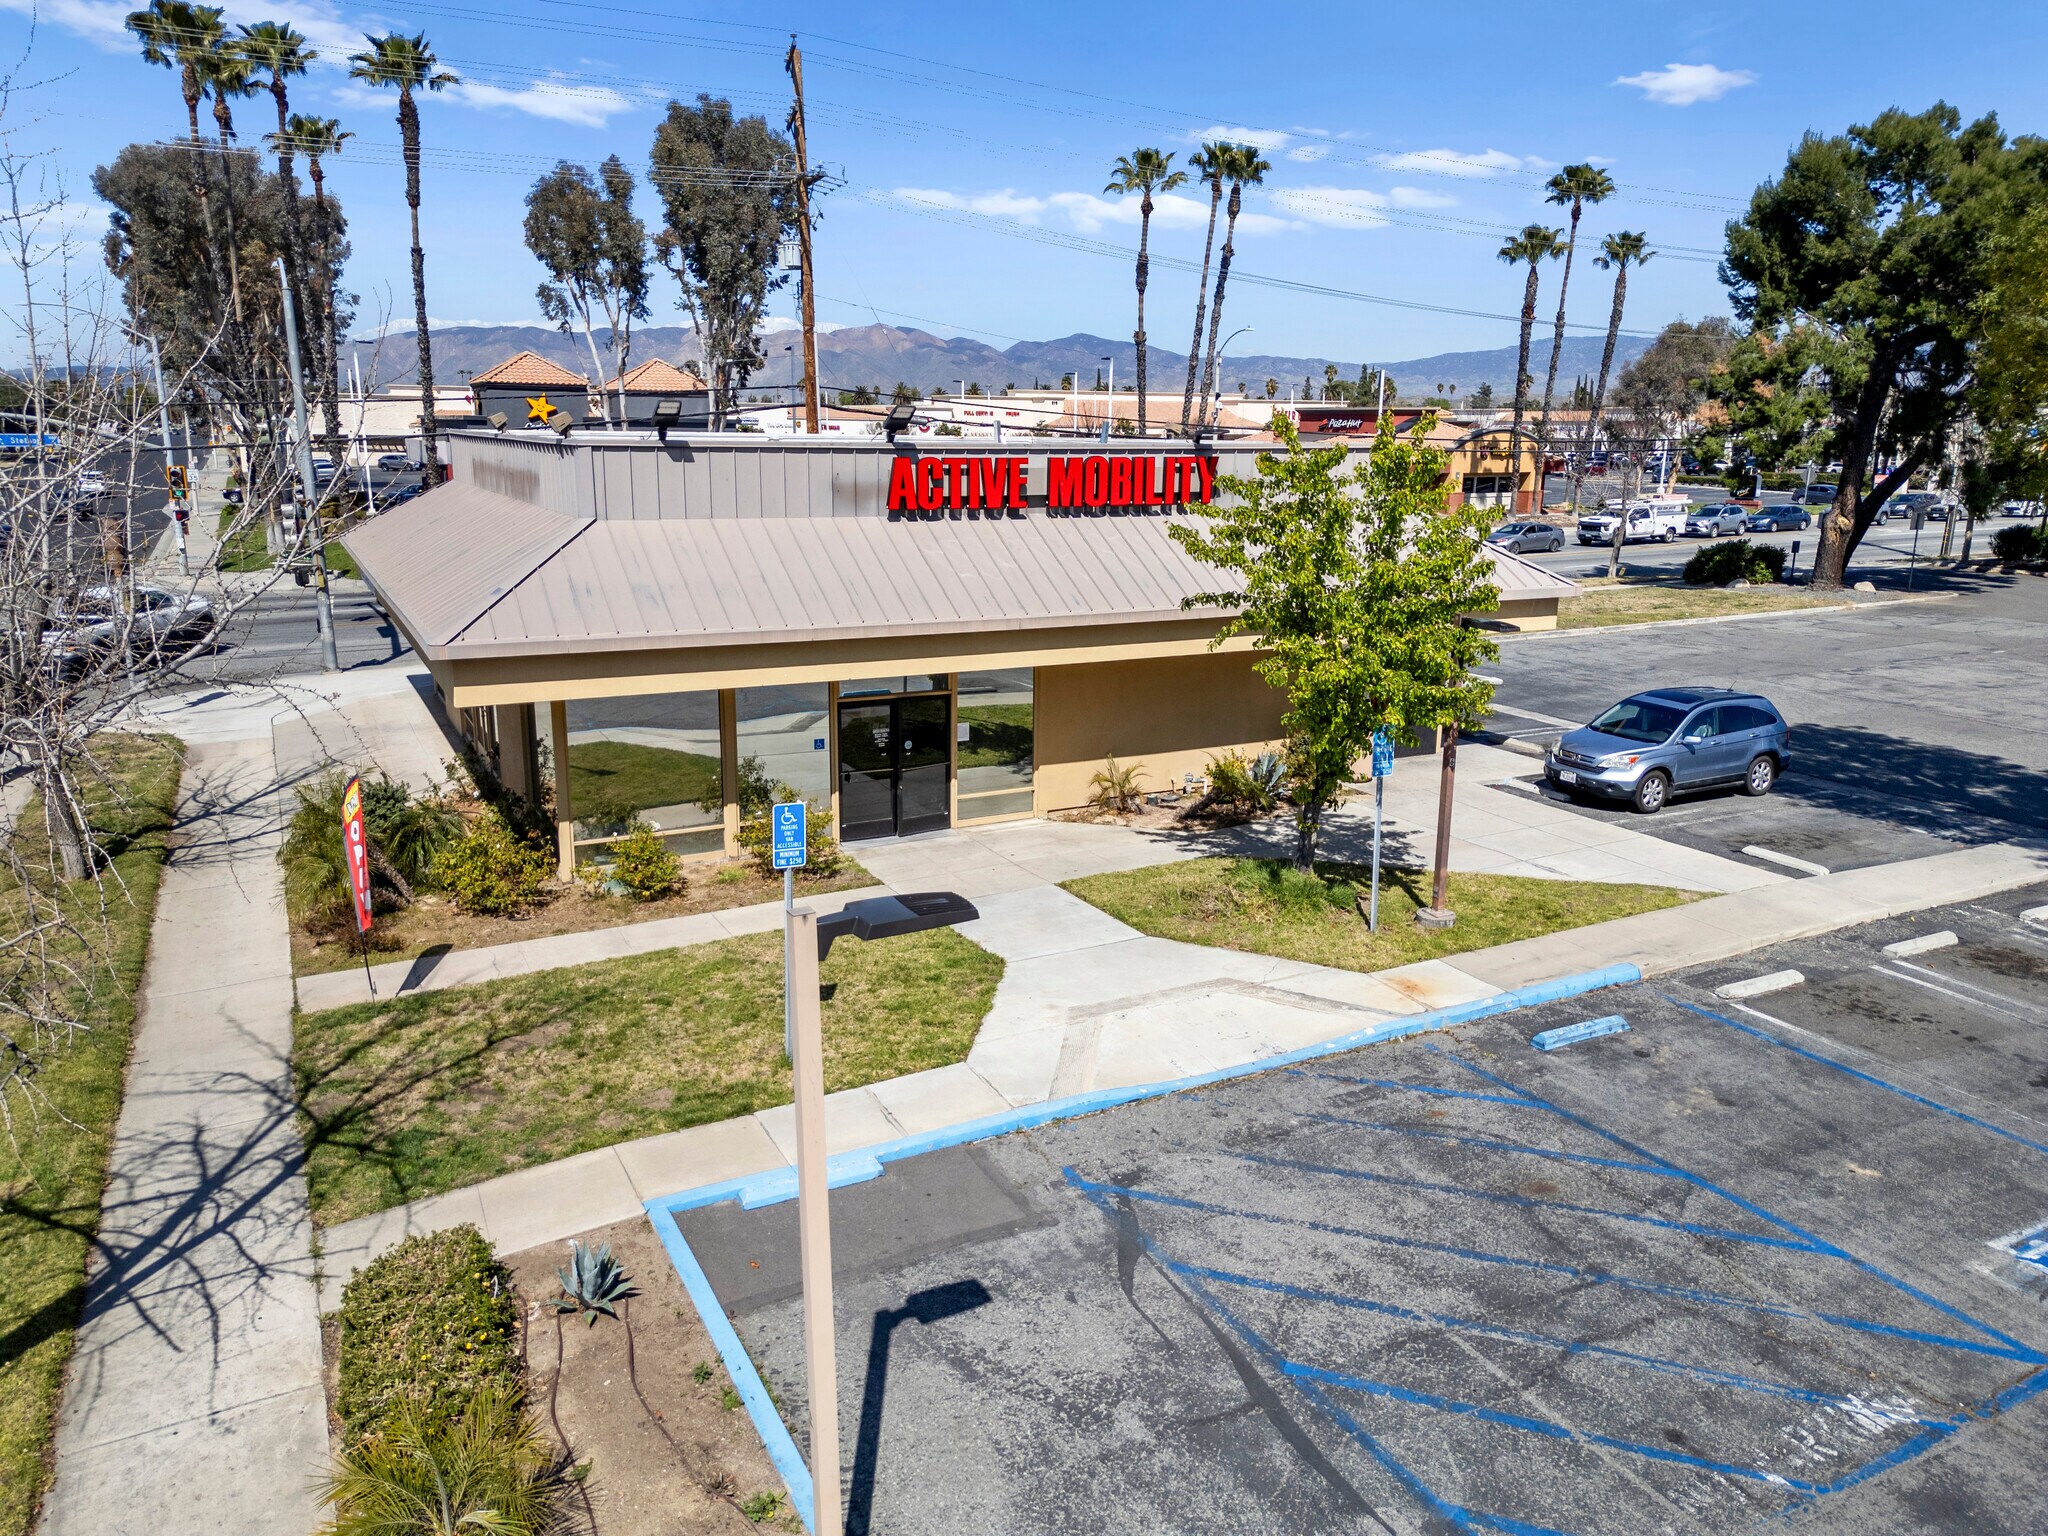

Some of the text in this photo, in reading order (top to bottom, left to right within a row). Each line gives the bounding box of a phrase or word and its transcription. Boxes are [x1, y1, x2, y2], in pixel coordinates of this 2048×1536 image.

[1328, 418, 1363, 428] Pizza Hut
[887, 455, 1219, 511] ACTIVE MOBILITY
